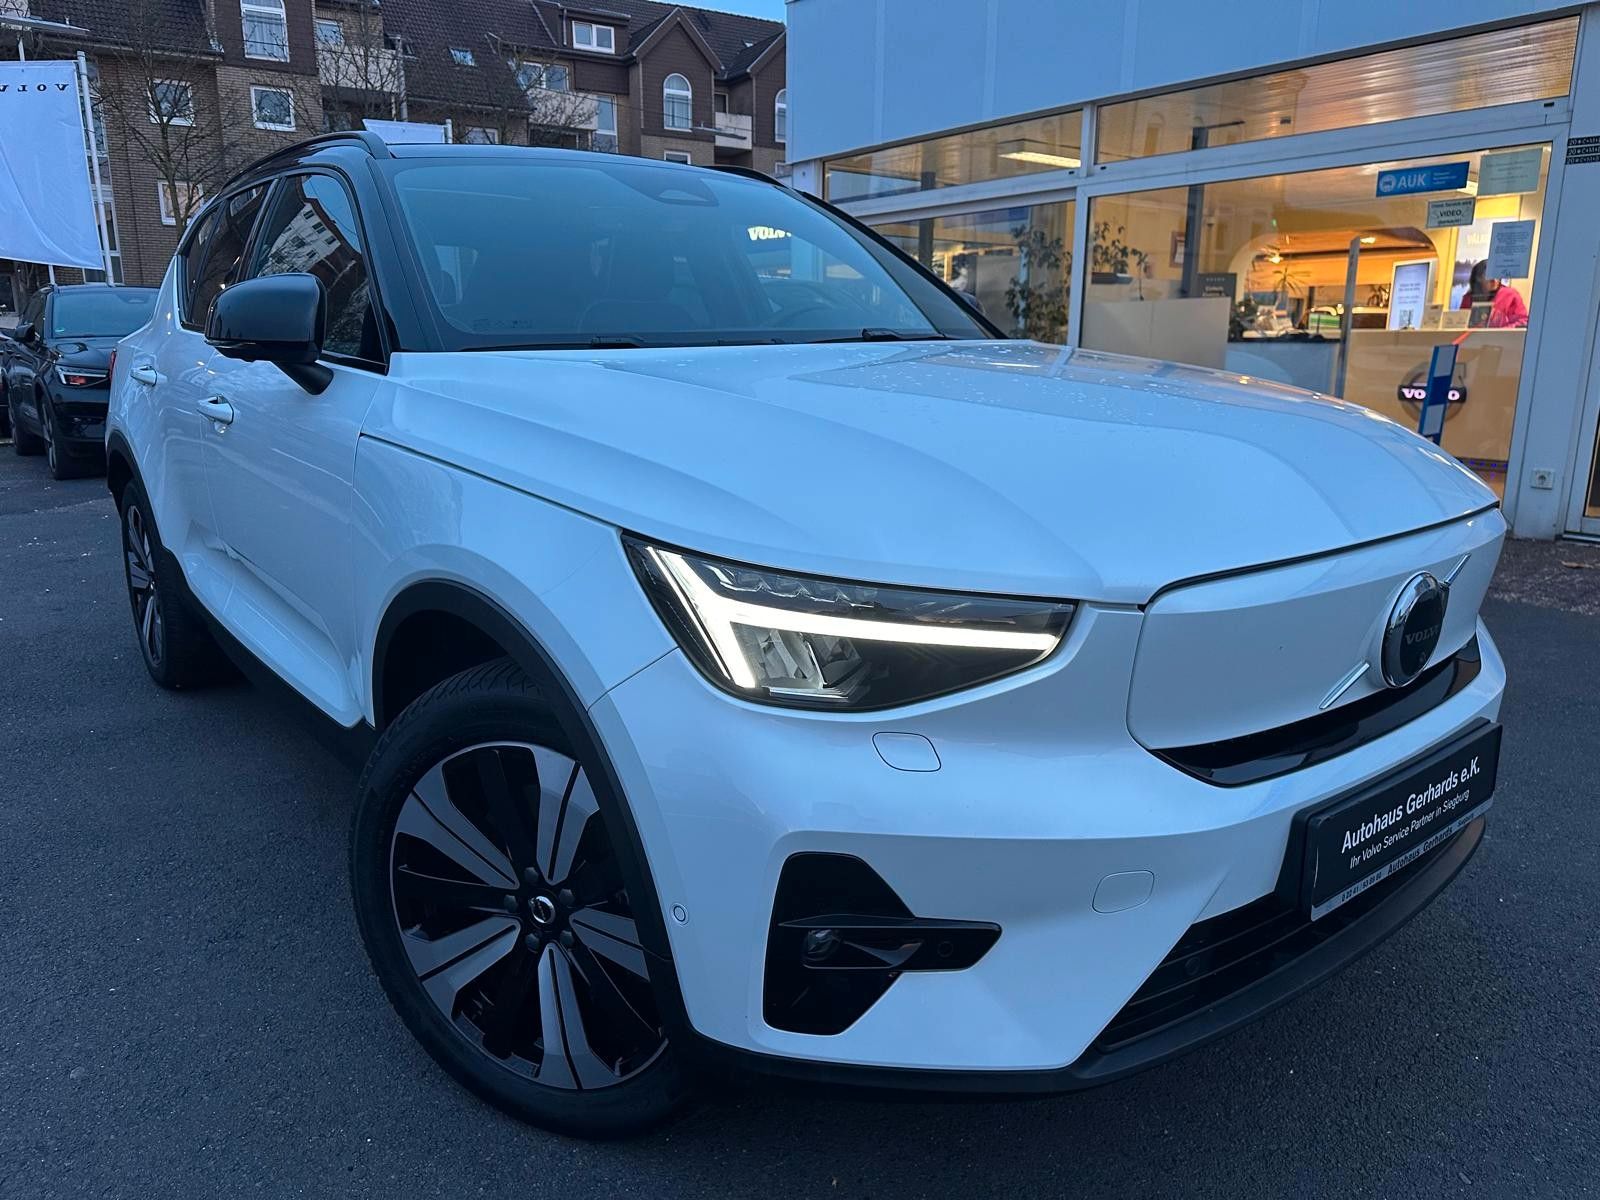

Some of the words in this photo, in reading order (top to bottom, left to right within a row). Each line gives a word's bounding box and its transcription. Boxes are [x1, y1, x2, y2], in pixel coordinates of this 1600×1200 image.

[1397, 173, 1427, 189] AUK
[1440, 209, 1462, 217] VIDEO
[747, 225, 792, 241] VOLV
[1401, 387, 1460, 401] VOO
[1405, 624, 1439, 645] VOLV
[1341, 804, 1404, 855] Autohaus
[1406, 770, 1459, 815] Gerhards
[1461, 756, 1480, 783] e.K.
[1349, 855, 1361, 870] Ihr
[1362, 842, 1382, 861] Volvo
[1383, 827, 1409, 849] Service
[1410, 811, 1435, 833] Partner
[1435, 806, 1442, 818] in
[1442, 789, 1470, 813] Siegburg
[1388, 849, 1421, 876] Autohaus
[1423, 826, 1453, 852] Gerhards
